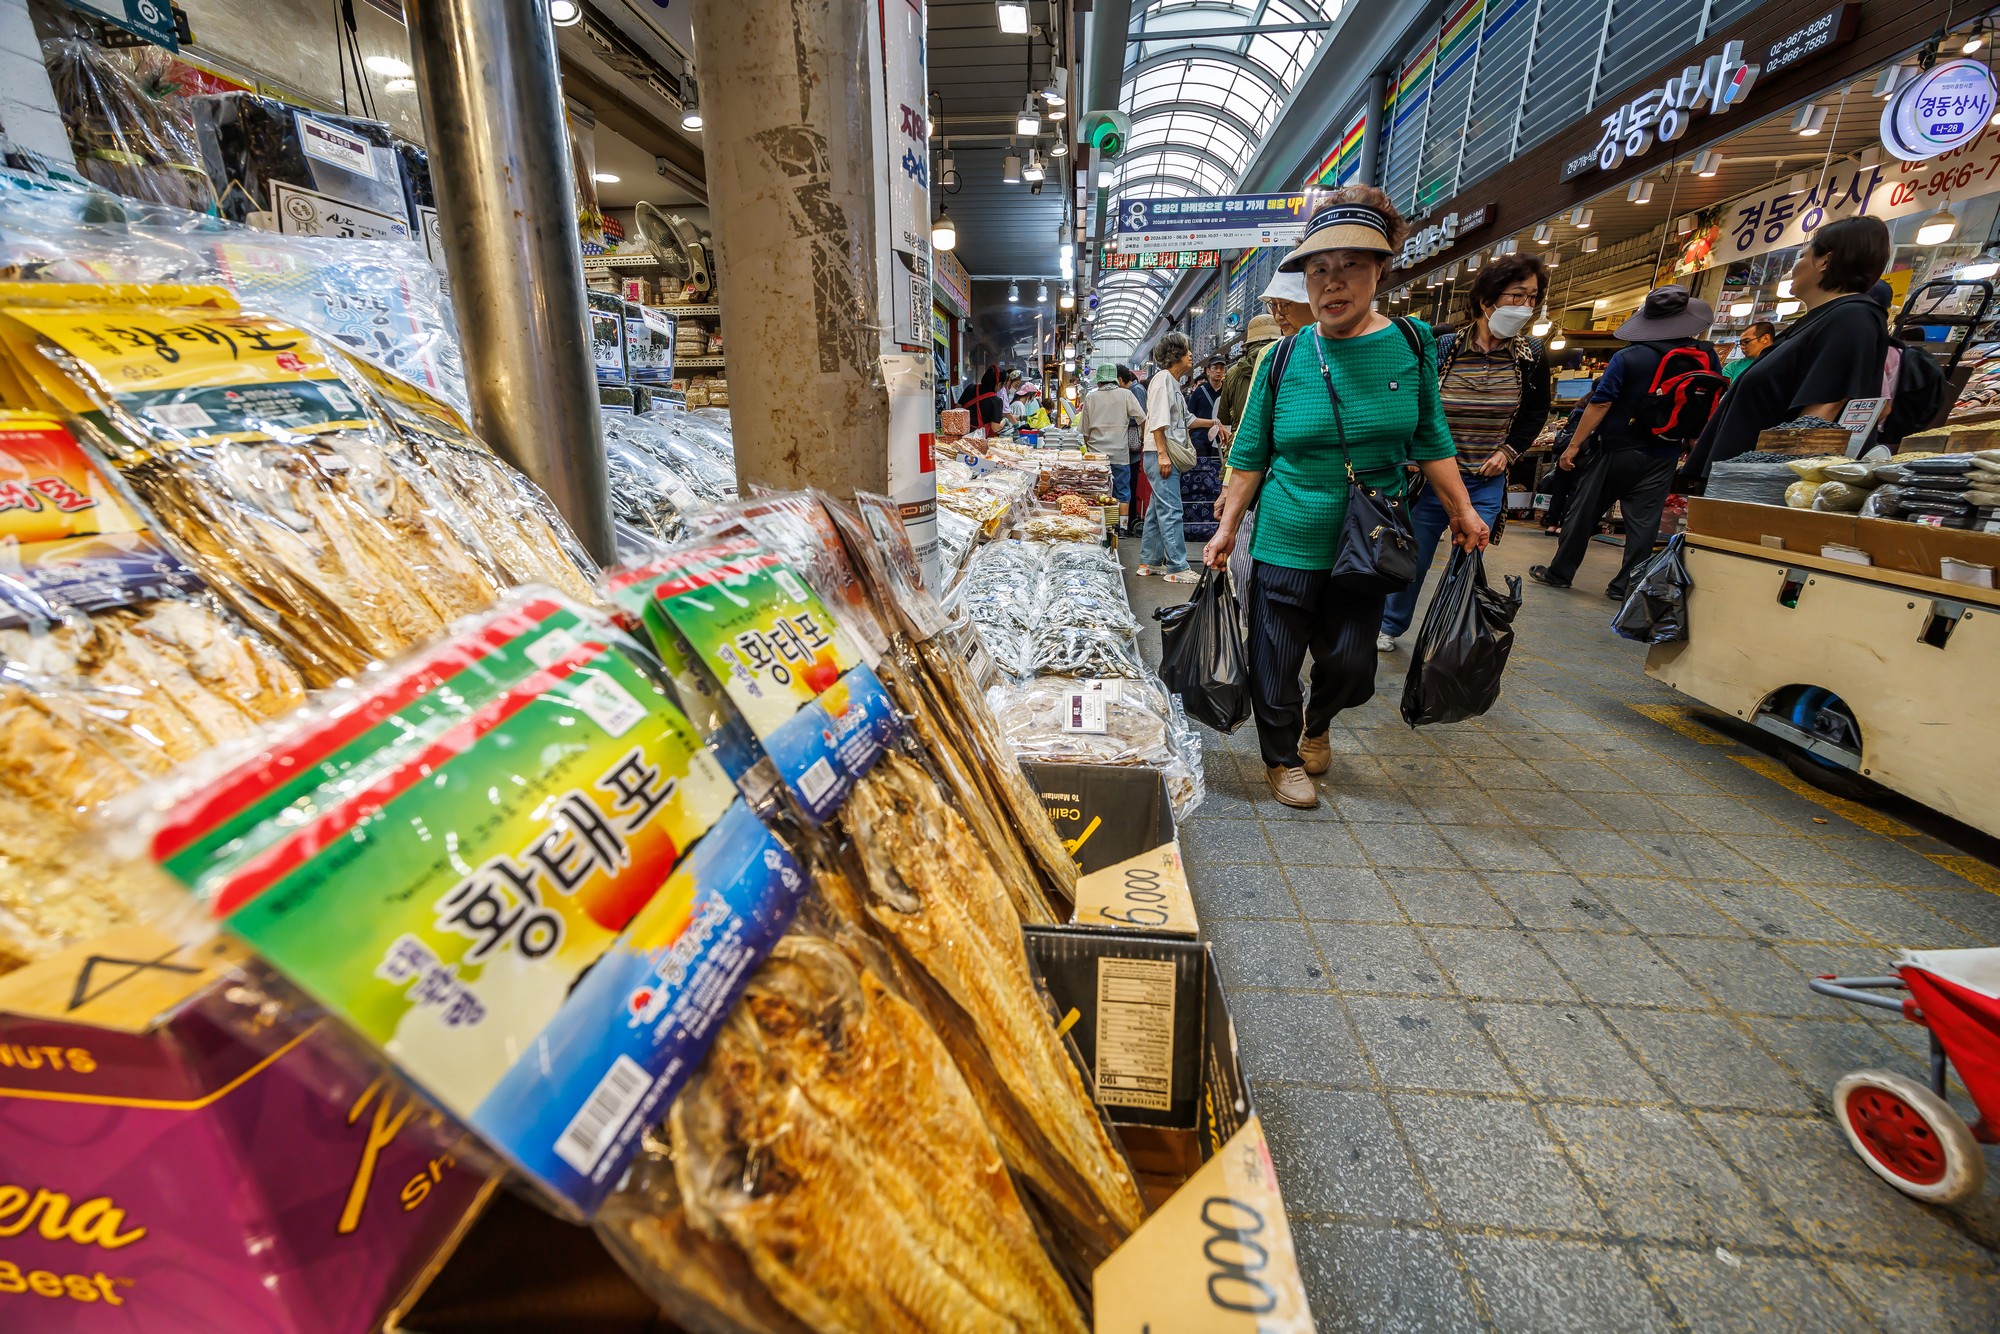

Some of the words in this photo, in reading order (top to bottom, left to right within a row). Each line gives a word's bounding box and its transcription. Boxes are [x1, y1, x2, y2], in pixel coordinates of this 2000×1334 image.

[1766, 31, 1828, 72] 02-966-7585
[1770, 14, 1832, 56] 02-967-8263
[1598, 42, 1734, 170] 경동상사
[1920, 94, 1987, 118] 경동상사
[1936, 124, 1958, 134] 나-28
[1152, 204, 1178, 214] 온라인
[1180, 202, 1222, 212] 마케팅으로
[1225, 200, 1244, 211] 우리
[1245, 199, 1264, 210] 가게
[1732, 165, 1884, 252] 경동상사
[740, 614, 829, 684] 황태포
[441, 750, 676, 959] 황태포
